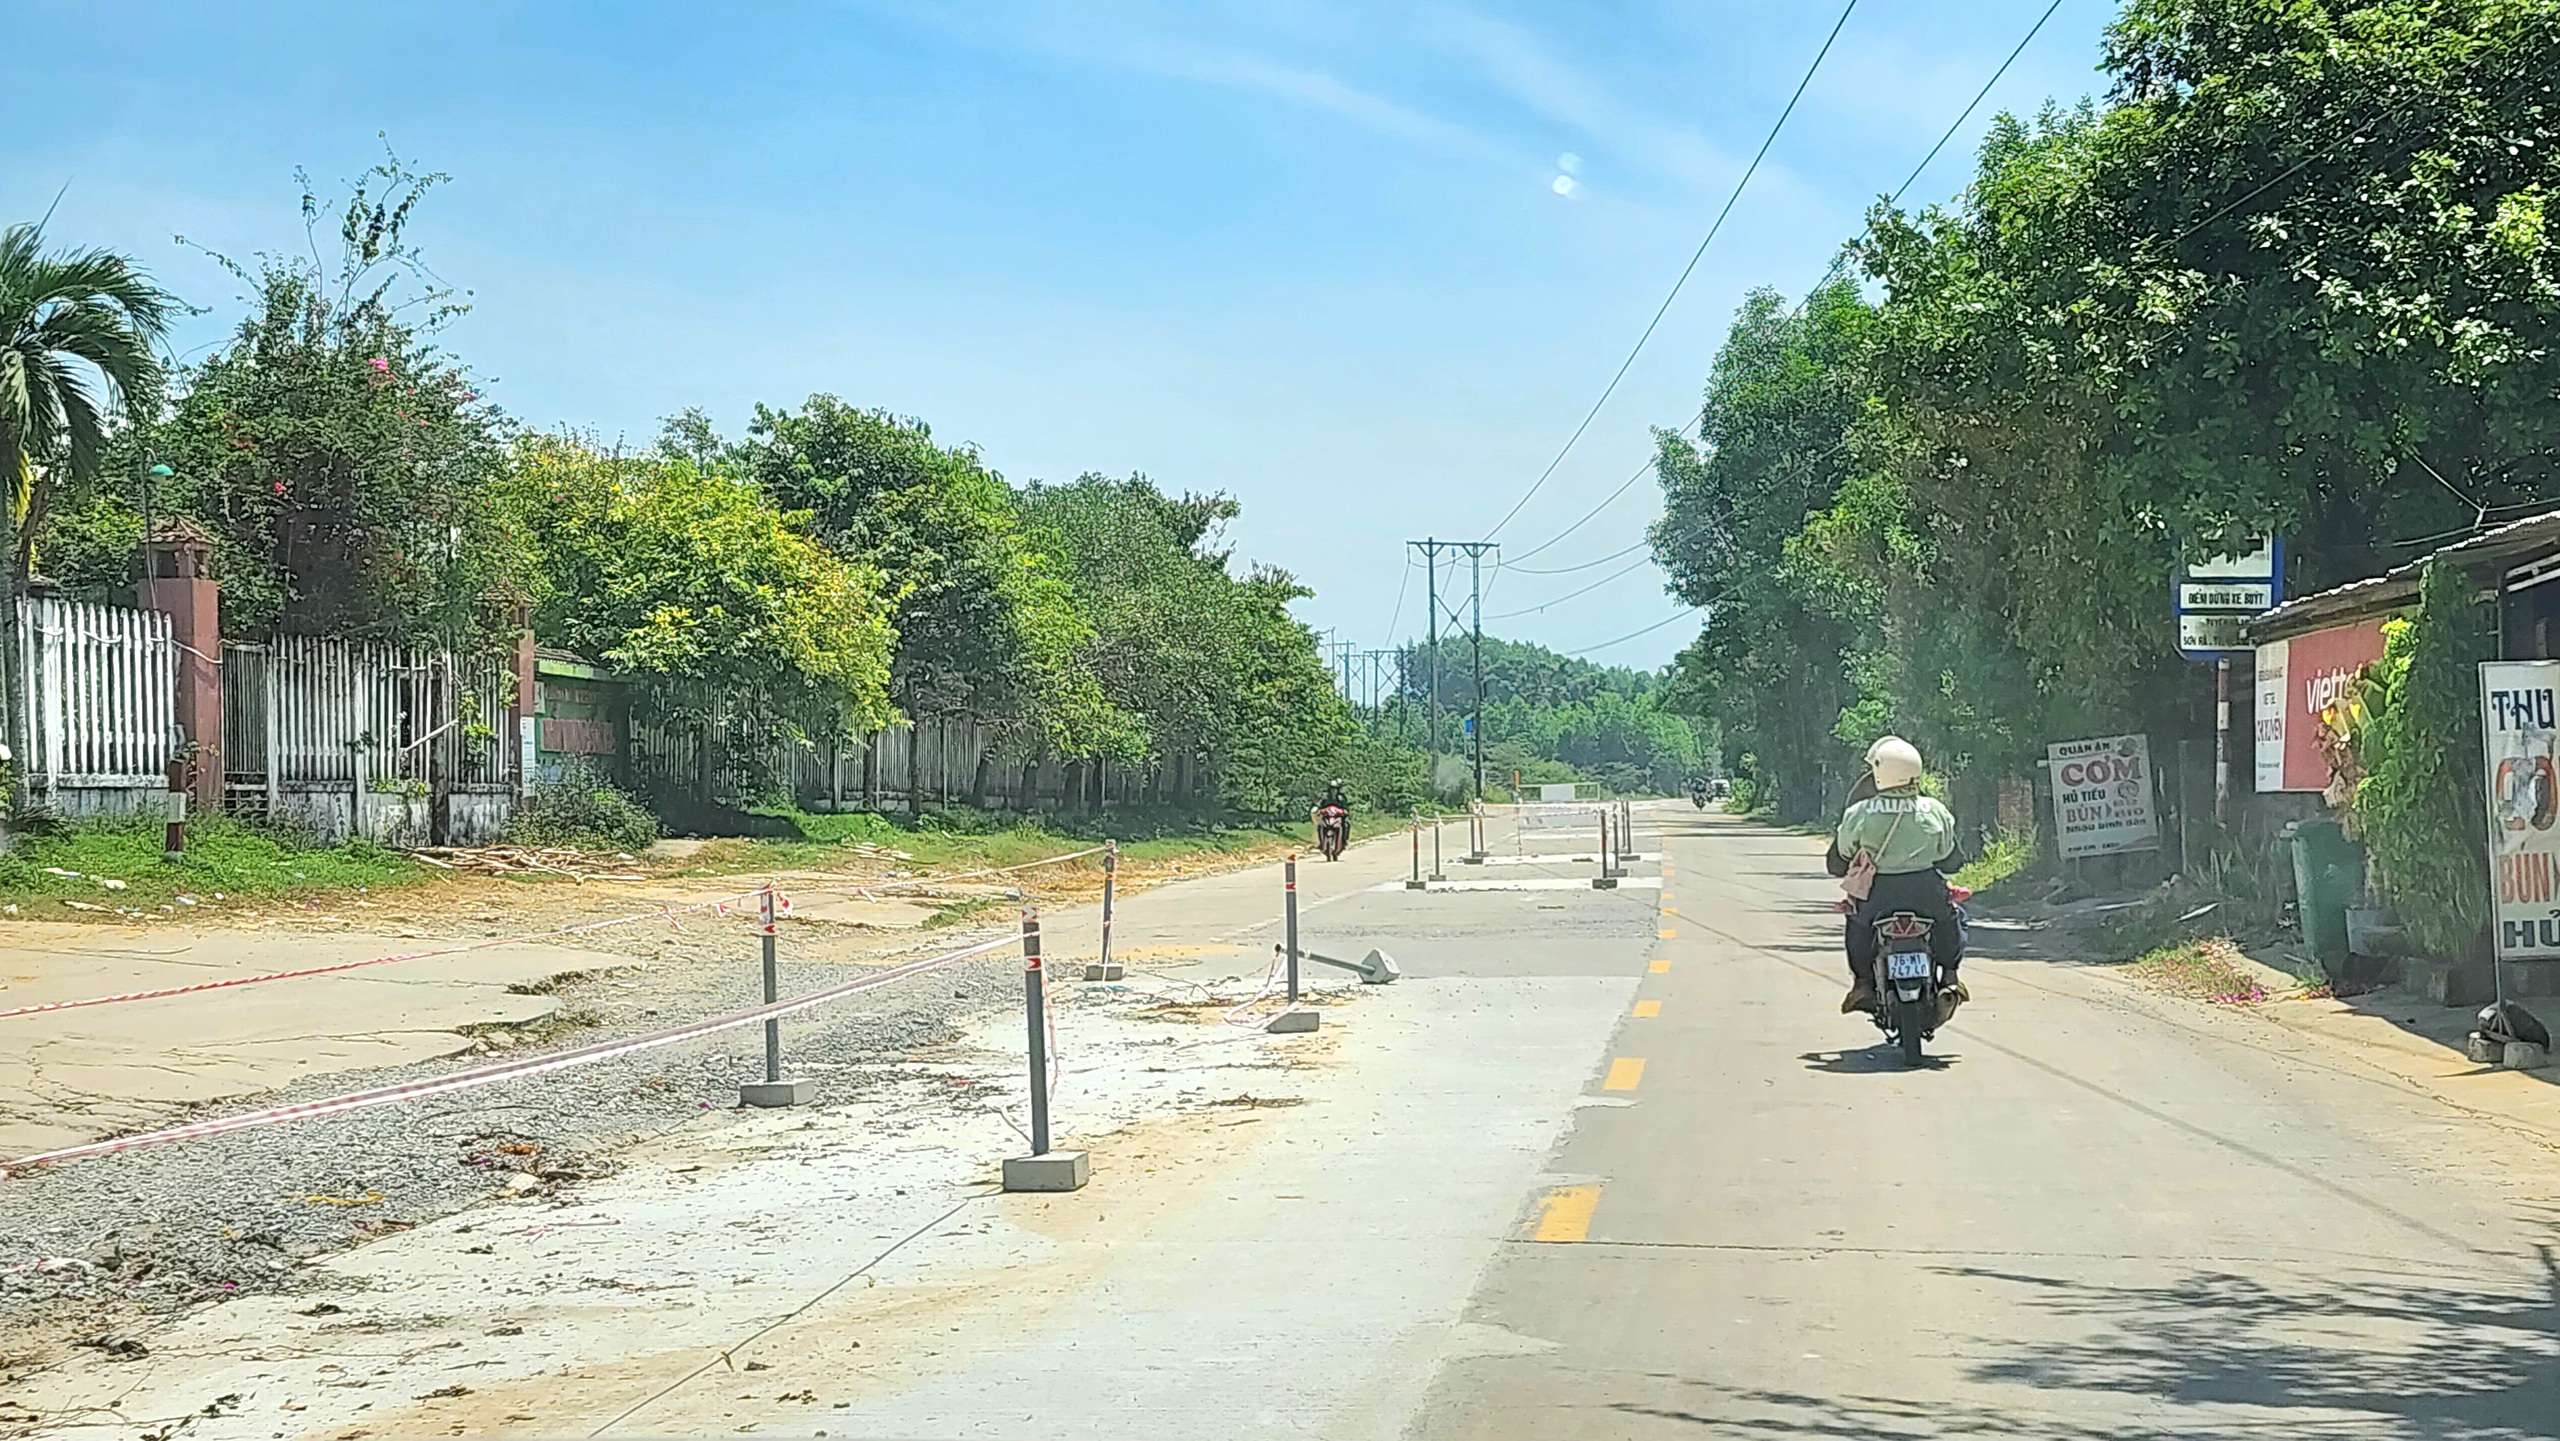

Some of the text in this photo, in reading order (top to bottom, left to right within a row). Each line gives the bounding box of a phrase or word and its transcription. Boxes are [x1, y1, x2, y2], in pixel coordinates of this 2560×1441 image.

[2231, 593, 2242, 604] XE
[2061, 755, 2142, 787] CƠM
[2062, 789, 2079, 804] HỦ
[2499, 841, 2550, 904] BÚN
